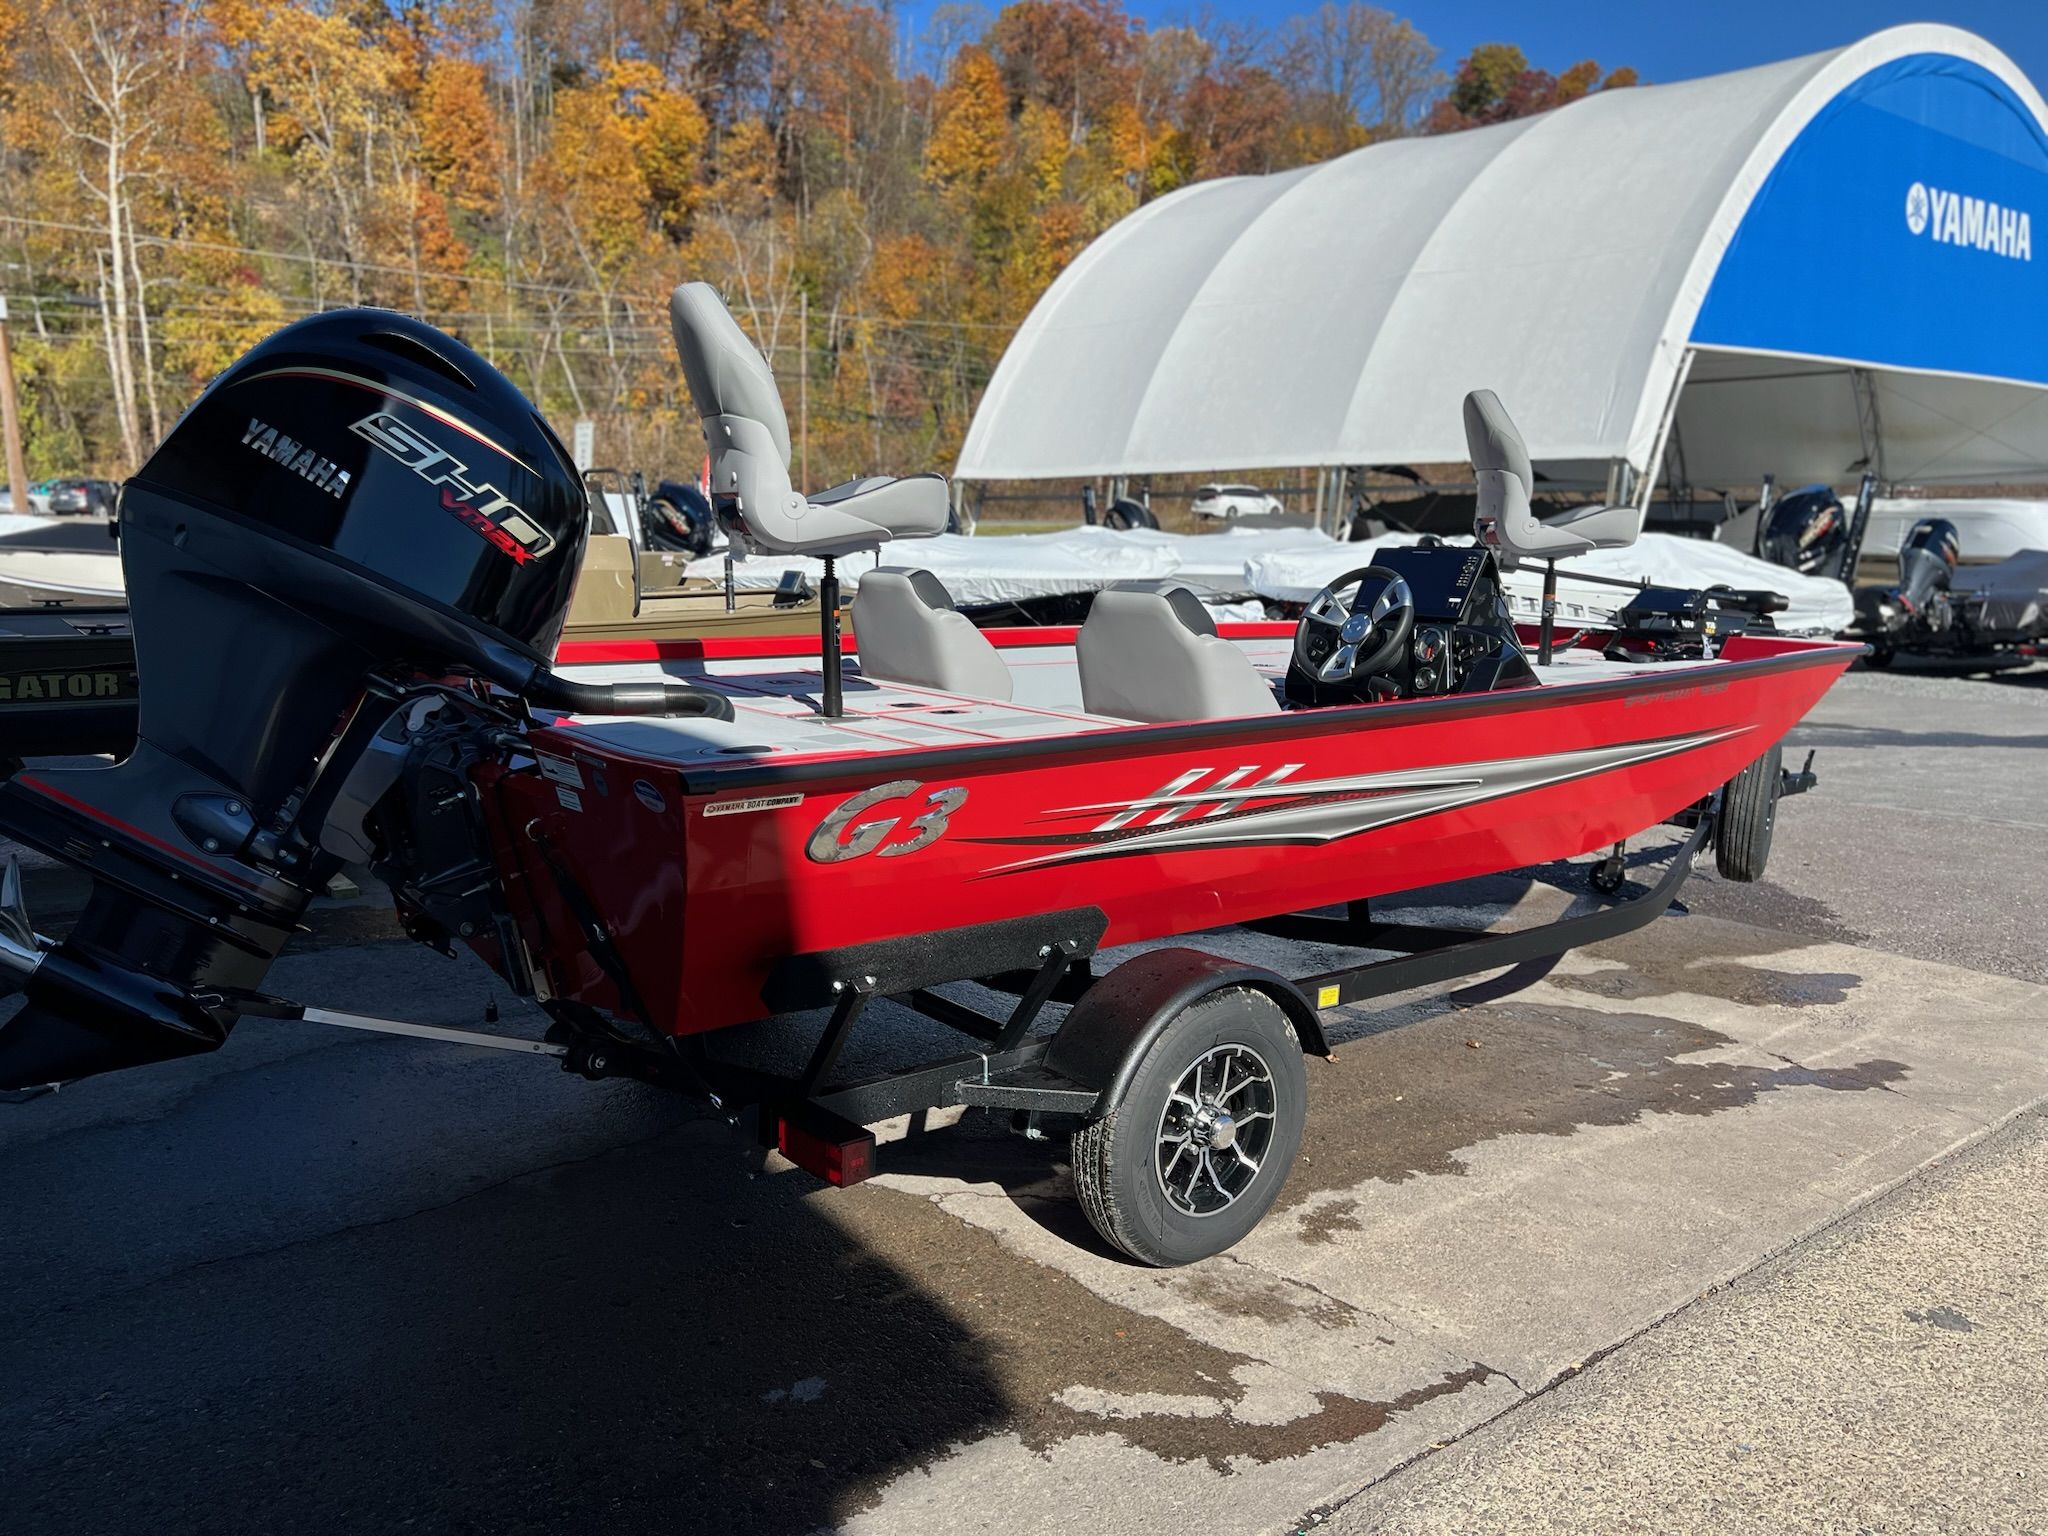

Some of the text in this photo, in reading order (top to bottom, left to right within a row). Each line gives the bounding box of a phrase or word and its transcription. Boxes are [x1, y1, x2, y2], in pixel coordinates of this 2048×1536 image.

[1929, 187, 2031, 262] YAMAHA
[241, 417, 352, 499] YAMAHA
[348, 411, 557, 558] SHO
[715, 796, 799, 812] YAMAHA BOAT COMPANY
[805, 779, 969, 863] G3
